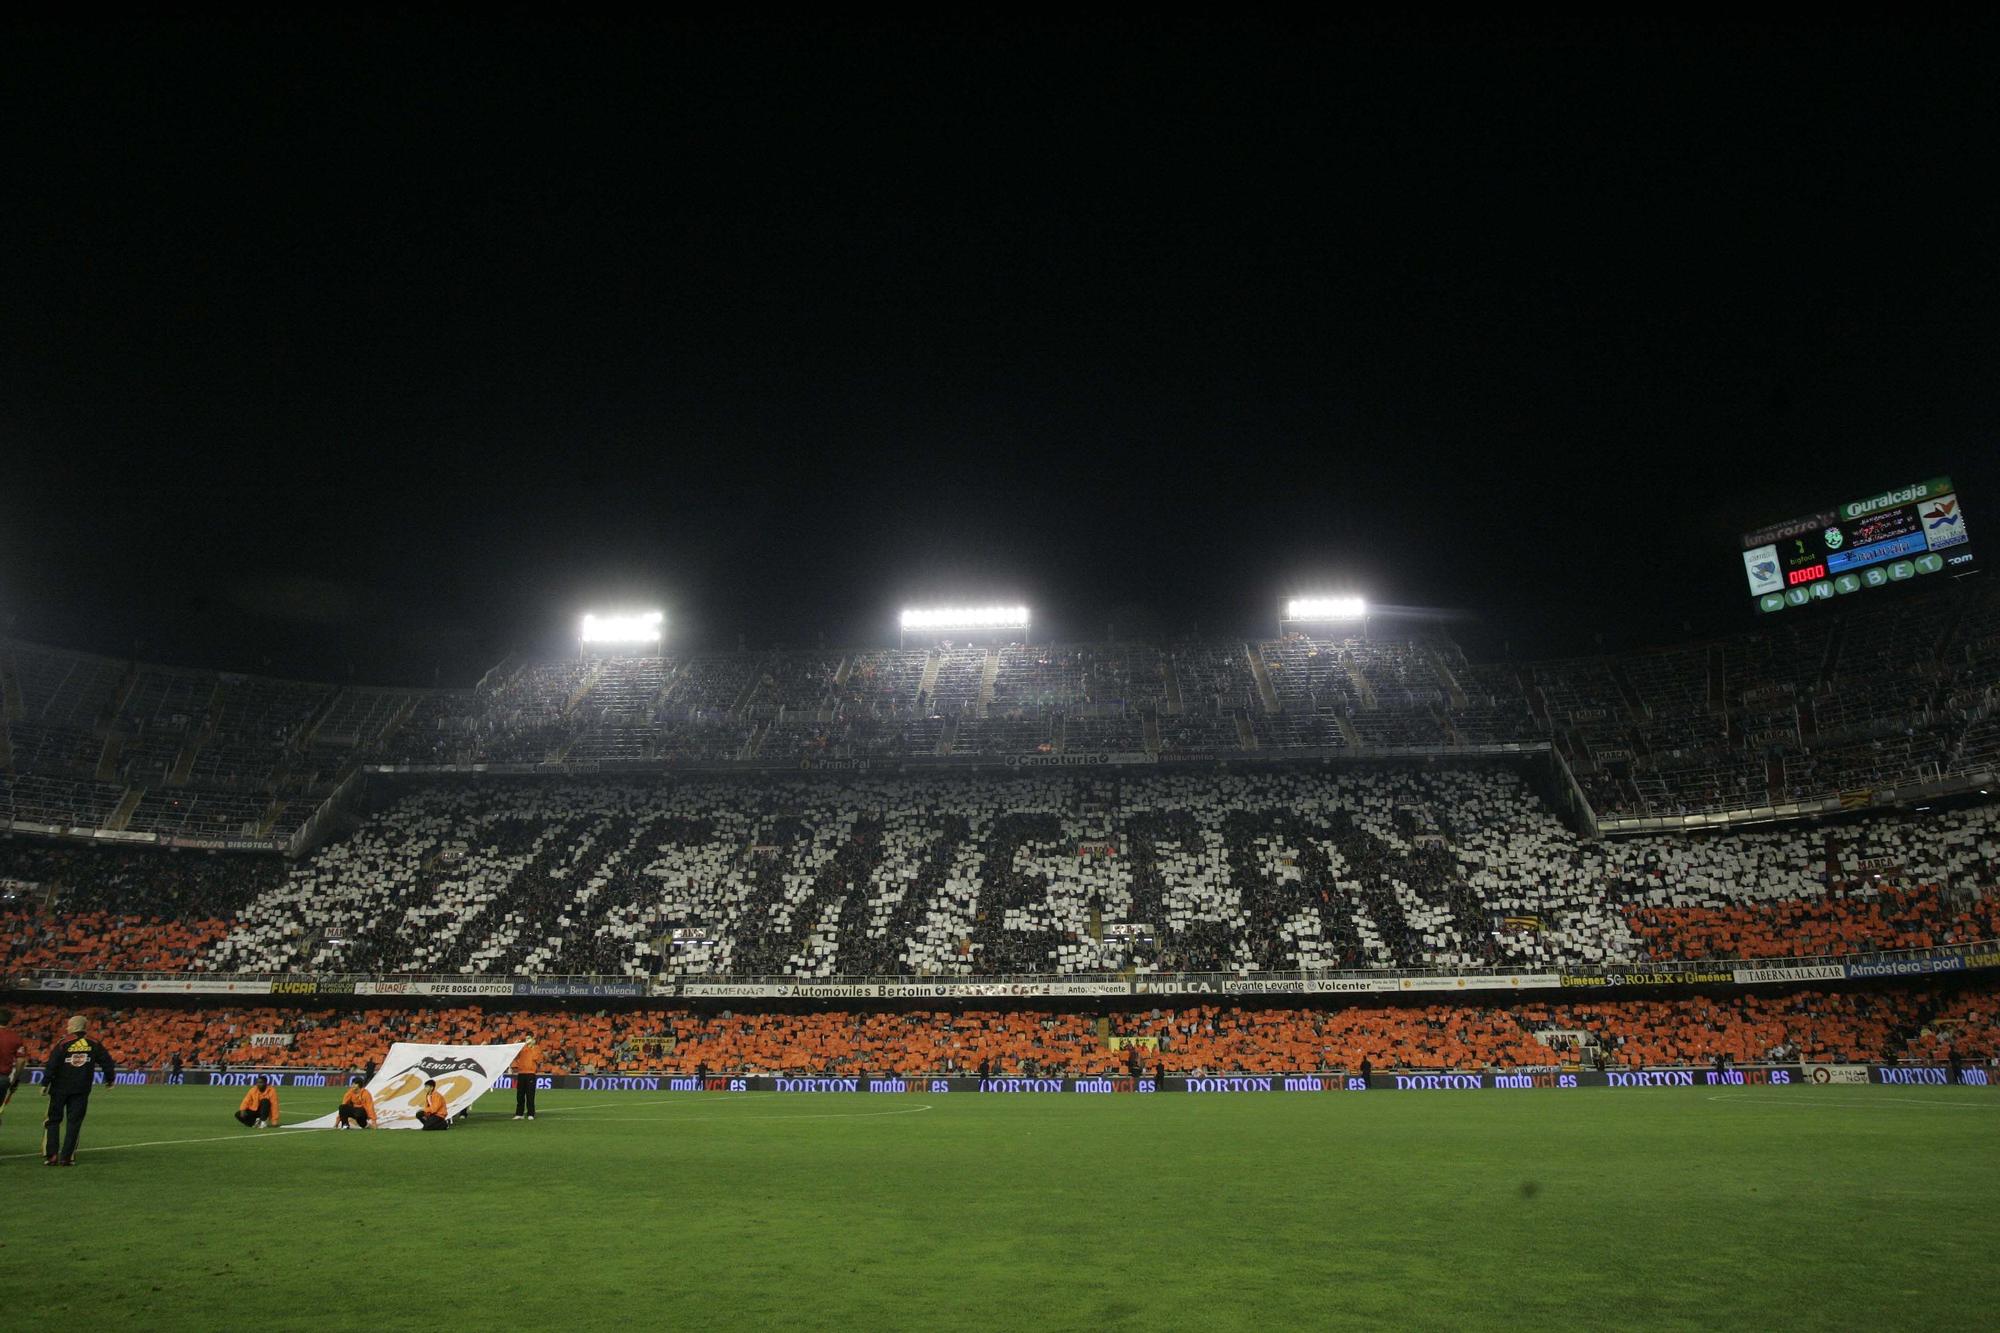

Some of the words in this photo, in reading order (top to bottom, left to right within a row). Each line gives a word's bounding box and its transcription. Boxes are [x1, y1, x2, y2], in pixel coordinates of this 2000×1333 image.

[1790, 553, 1816, 566] bigfoot
[1789, 565, 1825, 585] 0000
[1790, 556, 1934, 604] UNIBET
[1019, 754, 1097, 766] Canoturia
[1600, 751, 1626, 760] MARCA
[228, 841, 273, 849] DISCOTECA
[1858, 858, 1894, 870] MARCA
[1625, 974, 1674, 985] ROLEX
[1750, 970, 1792, 982] TABERNA
[1794, 967, 1842, 979] ALKAZAR
[71, 980, 113, 992] Atursa
[272, 982, 317, 994] FLYCAR
[431, 985, 450, 993] PEPE
[452, 985, 477, 993] BOSCA
[604, 986, 636, 995] Valencia
[701, 986, 765, 995] ALMENAR
[792, 985, 871, 997] Automóviles
[1225, 981, 1263, 991] Levante
[1318, 981, 1371, 991] Volcenter
[255, 1034, 285, 1046] MARCA
[1607, 1071, 1694, 1087] DORTON
[1880, 1066, 1948, 1084] DORTON
[580, 1077, 659, 1091] DORTON
[775, 1078, 858, 1092] DORTON
[979, 1079, 1064, 1092] DORTON
[1186, 1078, 1272, 1092] DORTON
[1396, 1075, 1483, 1090] DORTON
